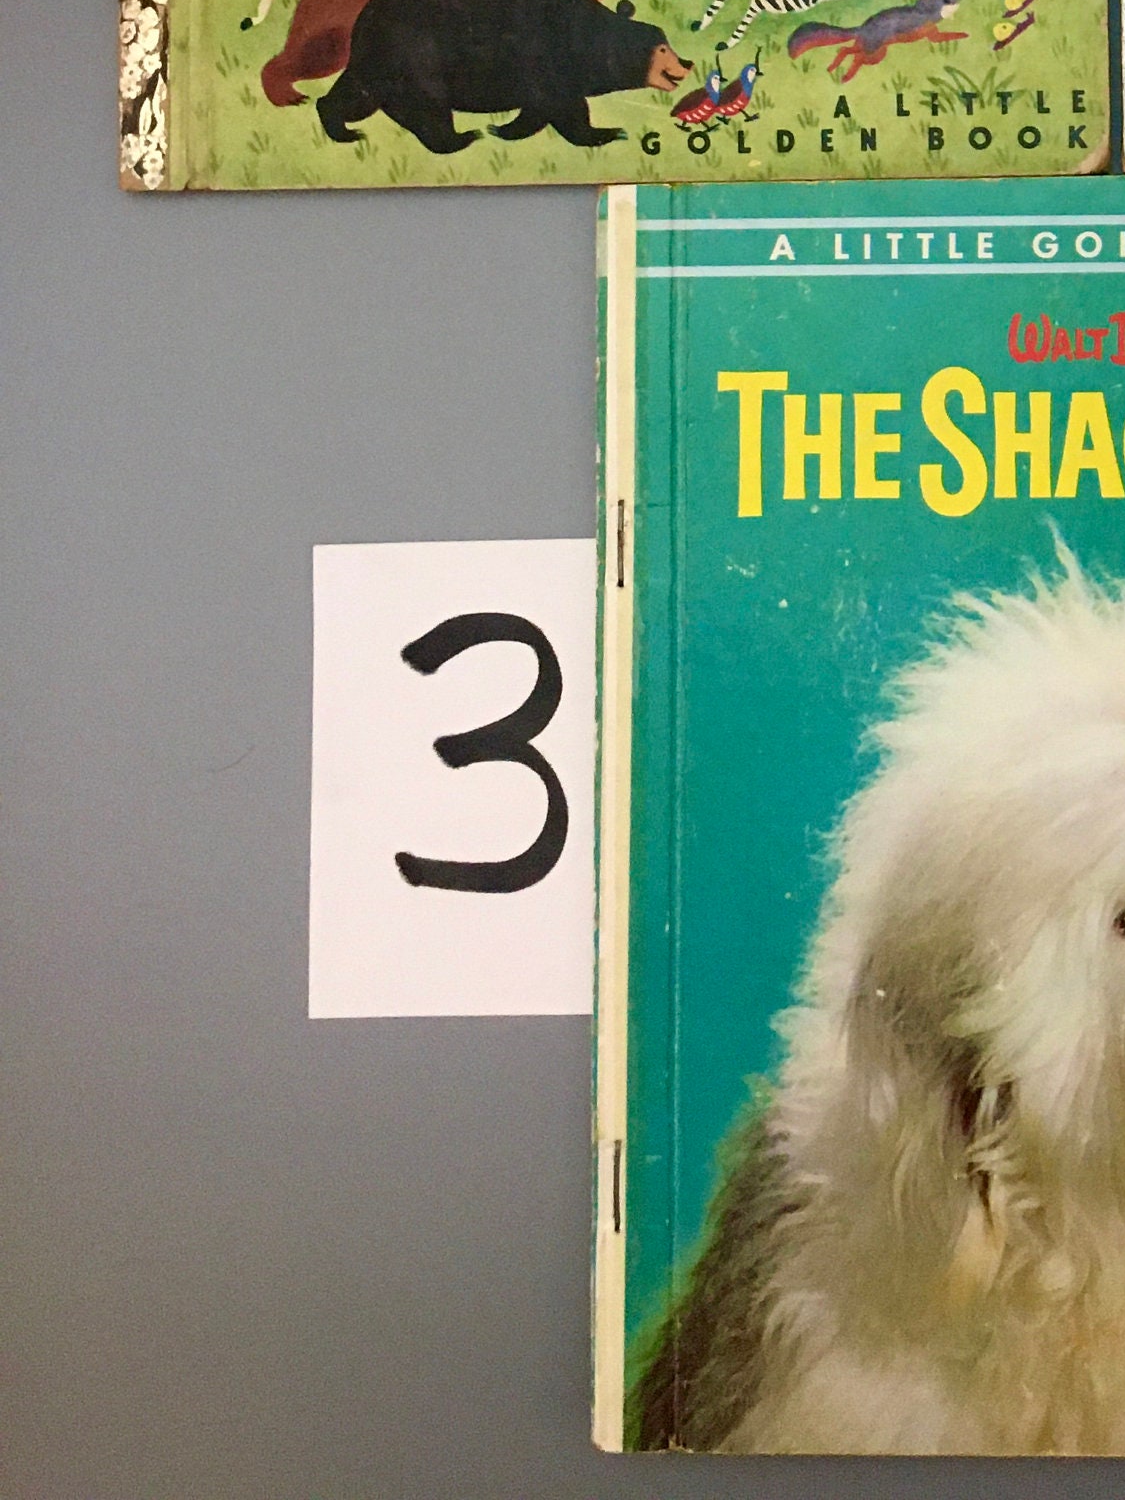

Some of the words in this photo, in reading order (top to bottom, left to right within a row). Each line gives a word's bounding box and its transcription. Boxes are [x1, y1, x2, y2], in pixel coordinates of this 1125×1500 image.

[834, 95, 851, 118] A
[896, 90, 1087, 117] LITTLE
[641, 128, 877, 156] GOLDEN
[928, 125, 1089, 151] BOOK
[769, 234, 796, 261] A
[834, 232, 994, 259] LITTLE
[1008, 312, 1109, 363] WALT
[395, 612, 569, 893] 3
